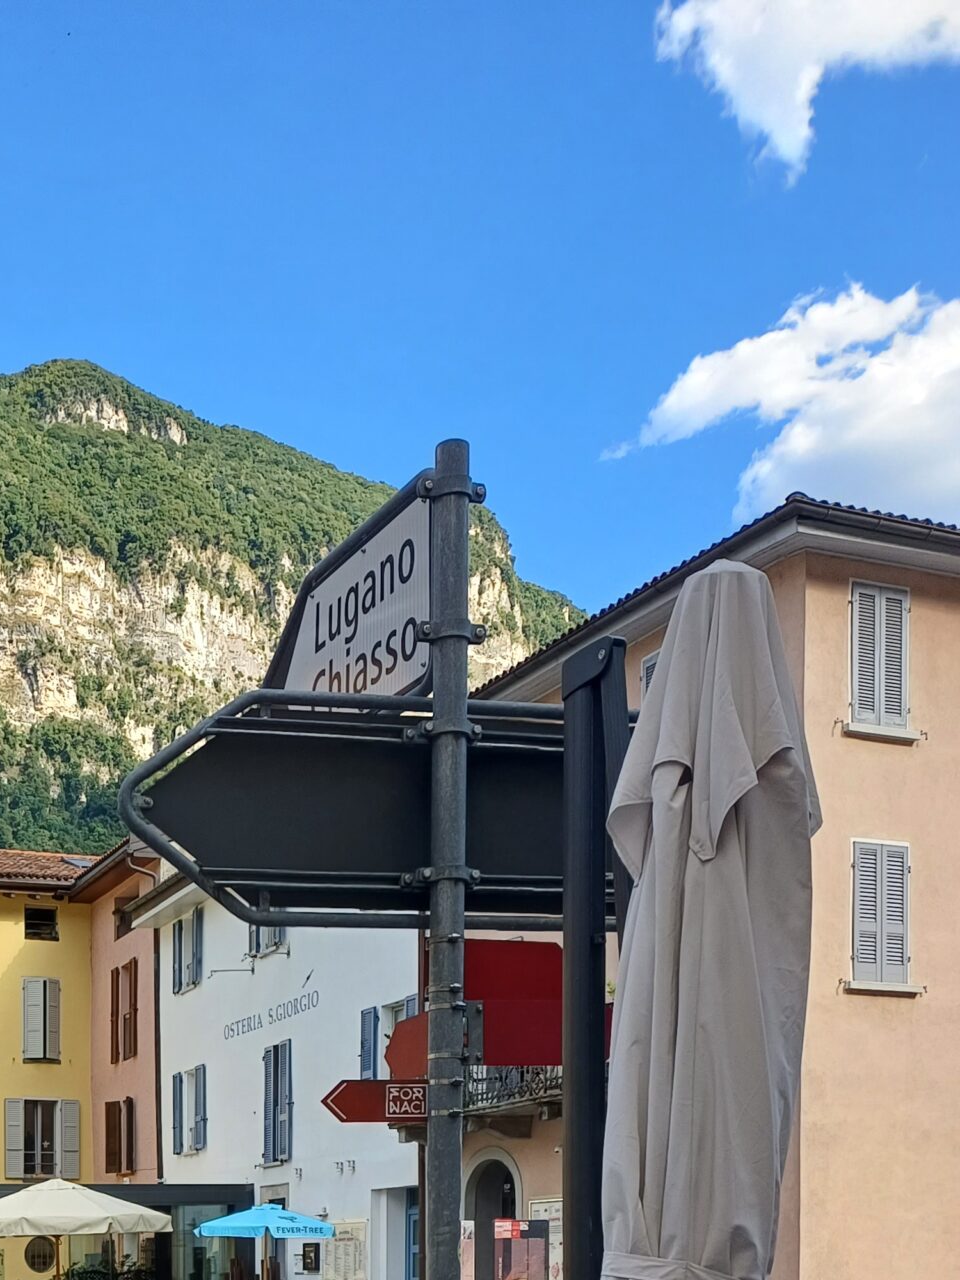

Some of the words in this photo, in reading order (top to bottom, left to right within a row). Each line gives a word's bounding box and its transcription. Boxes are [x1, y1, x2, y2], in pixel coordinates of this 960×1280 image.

[314, 538, 415, 654] Lugano
[223, 1013, 263, 1040] OSTERIA
[268, 990, 320, 1025] S.GIORGIO
[389, 1087, 424, 1100] FOR
[389, 1101, 425, 1114] NACI
